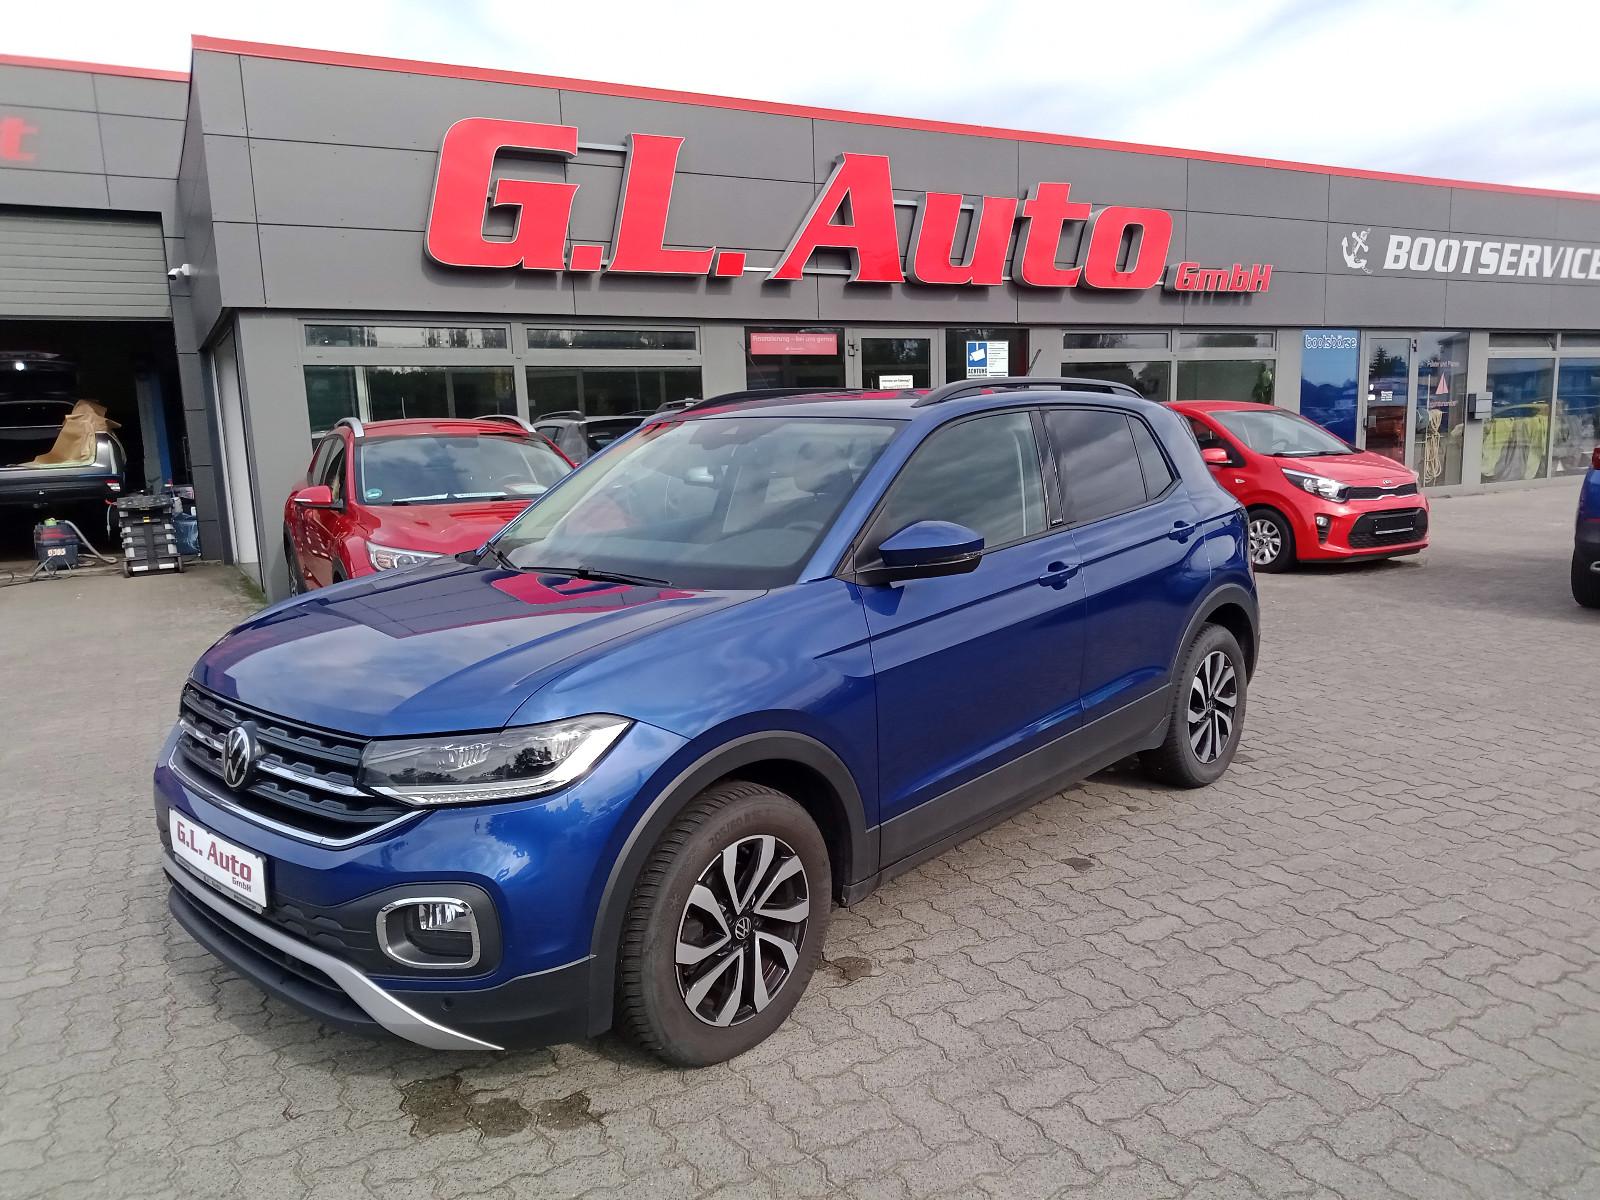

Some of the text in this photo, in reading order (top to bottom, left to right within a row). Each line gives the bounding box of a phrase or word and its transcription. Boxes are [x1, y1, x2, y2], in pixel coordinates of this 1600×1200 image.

[424, 117, 1173, 290] G.L. Auto
[1169, 262, 1274, 293] GmbH
[1383, 234, 1600, 280] BOOTSERVICE
[176, 820, 252, 882] G.L. Auto
